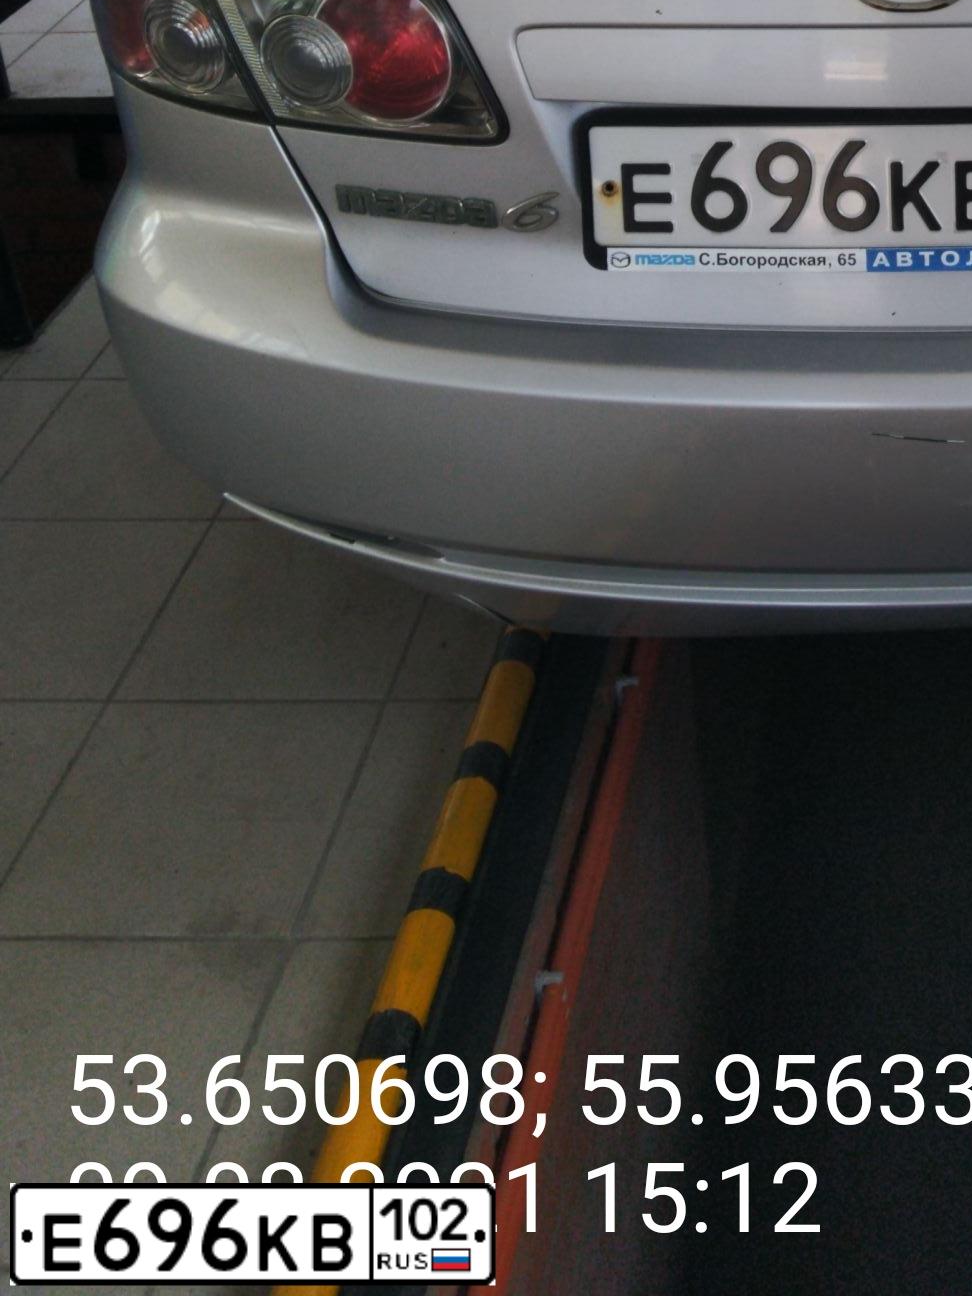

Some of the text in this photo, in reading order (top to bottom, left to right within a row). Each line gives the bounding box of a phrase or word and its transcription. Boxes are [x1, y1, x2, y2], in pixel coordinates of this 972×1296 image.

[501, 191, 560, 233] 6
[634, 254, 696, 266] mazda
[699, 253, 832, 269] С.Богородская,
[837, 253, 857, 266] 65
